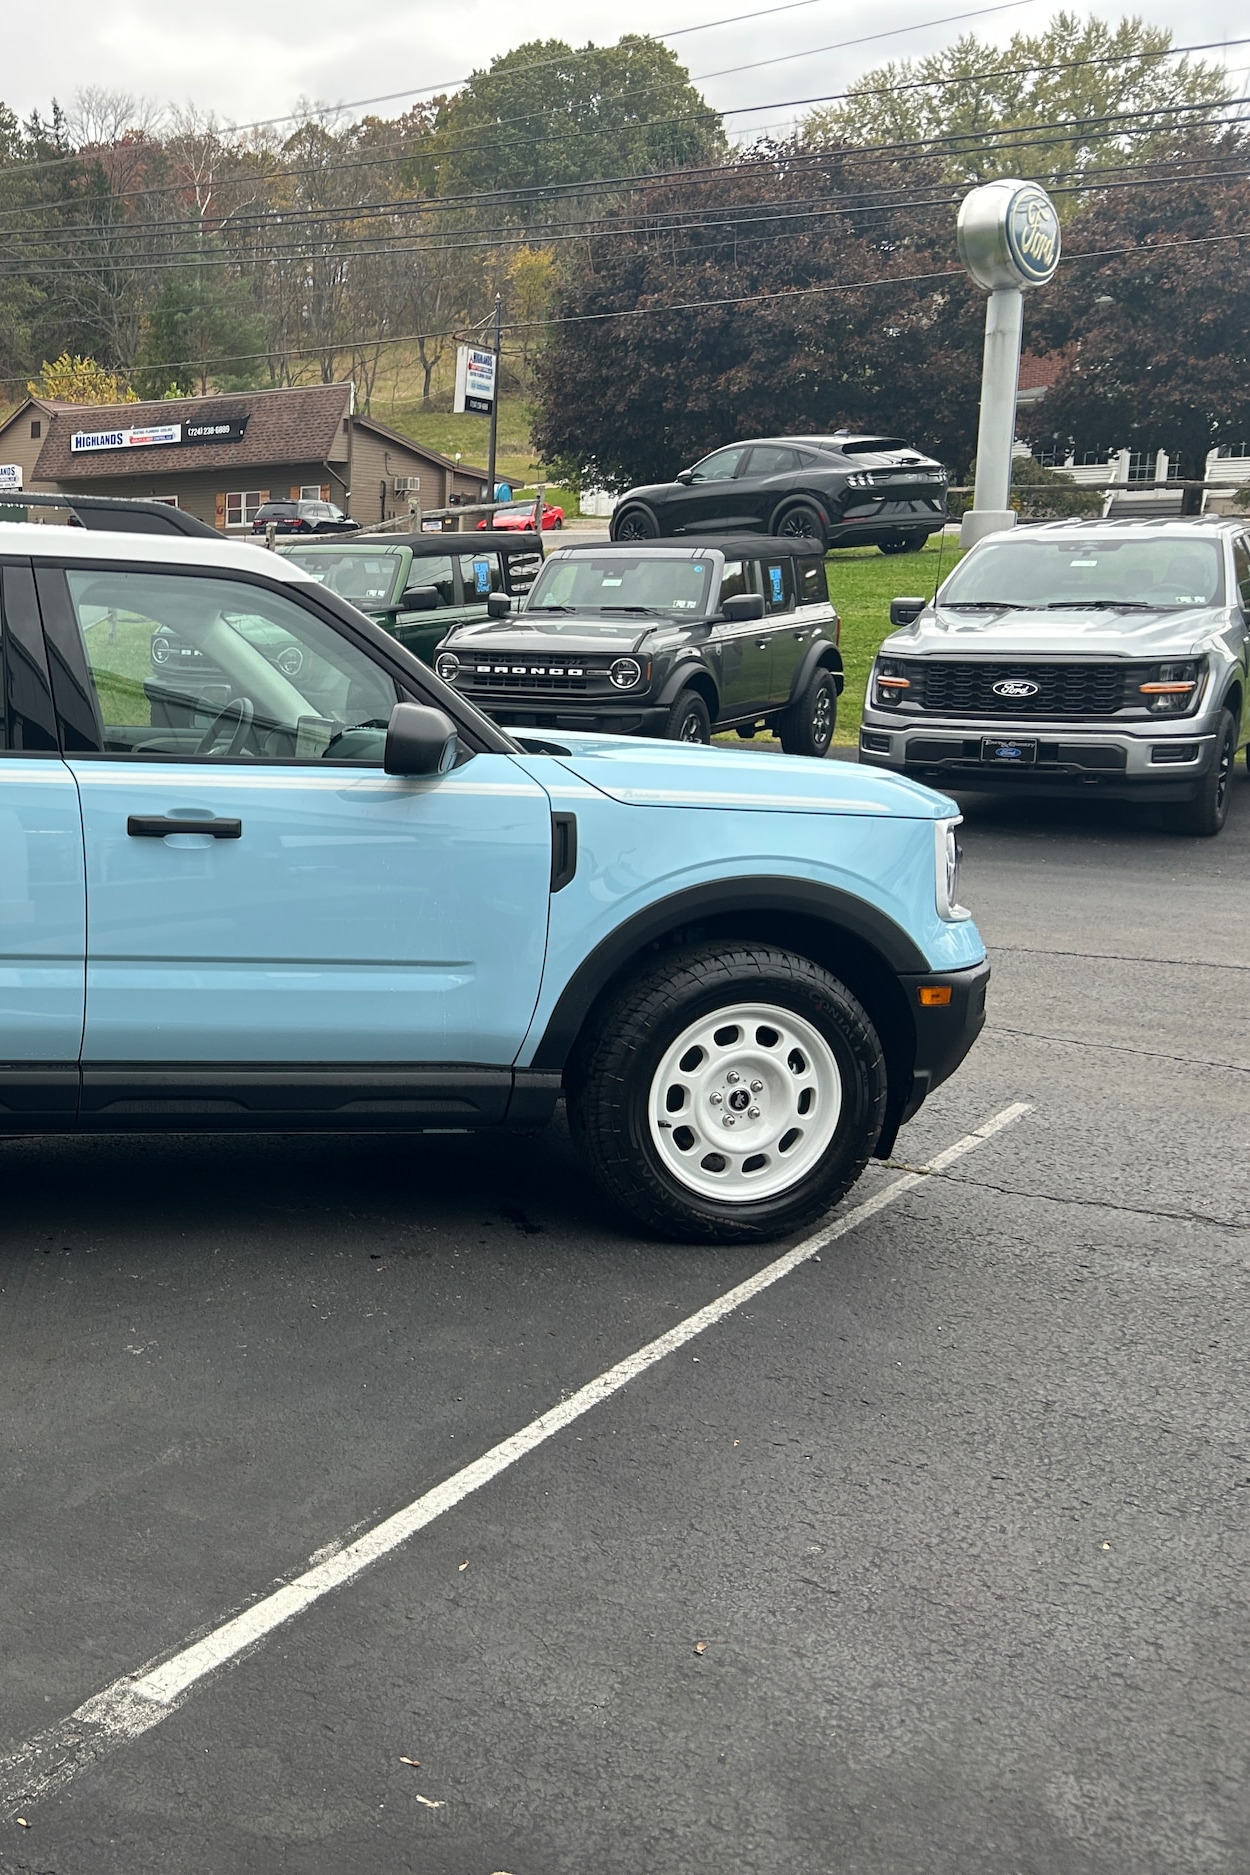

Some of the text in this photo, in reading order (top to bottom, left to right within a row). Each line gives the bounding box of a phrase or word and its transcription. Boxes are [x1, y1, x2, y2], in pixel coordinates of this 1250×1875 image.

[1021, 202, 1057, 266] Ford
[75, 432, 123, 449] HIGHLANDS
[476, 665, 584, 676] BRONCO
